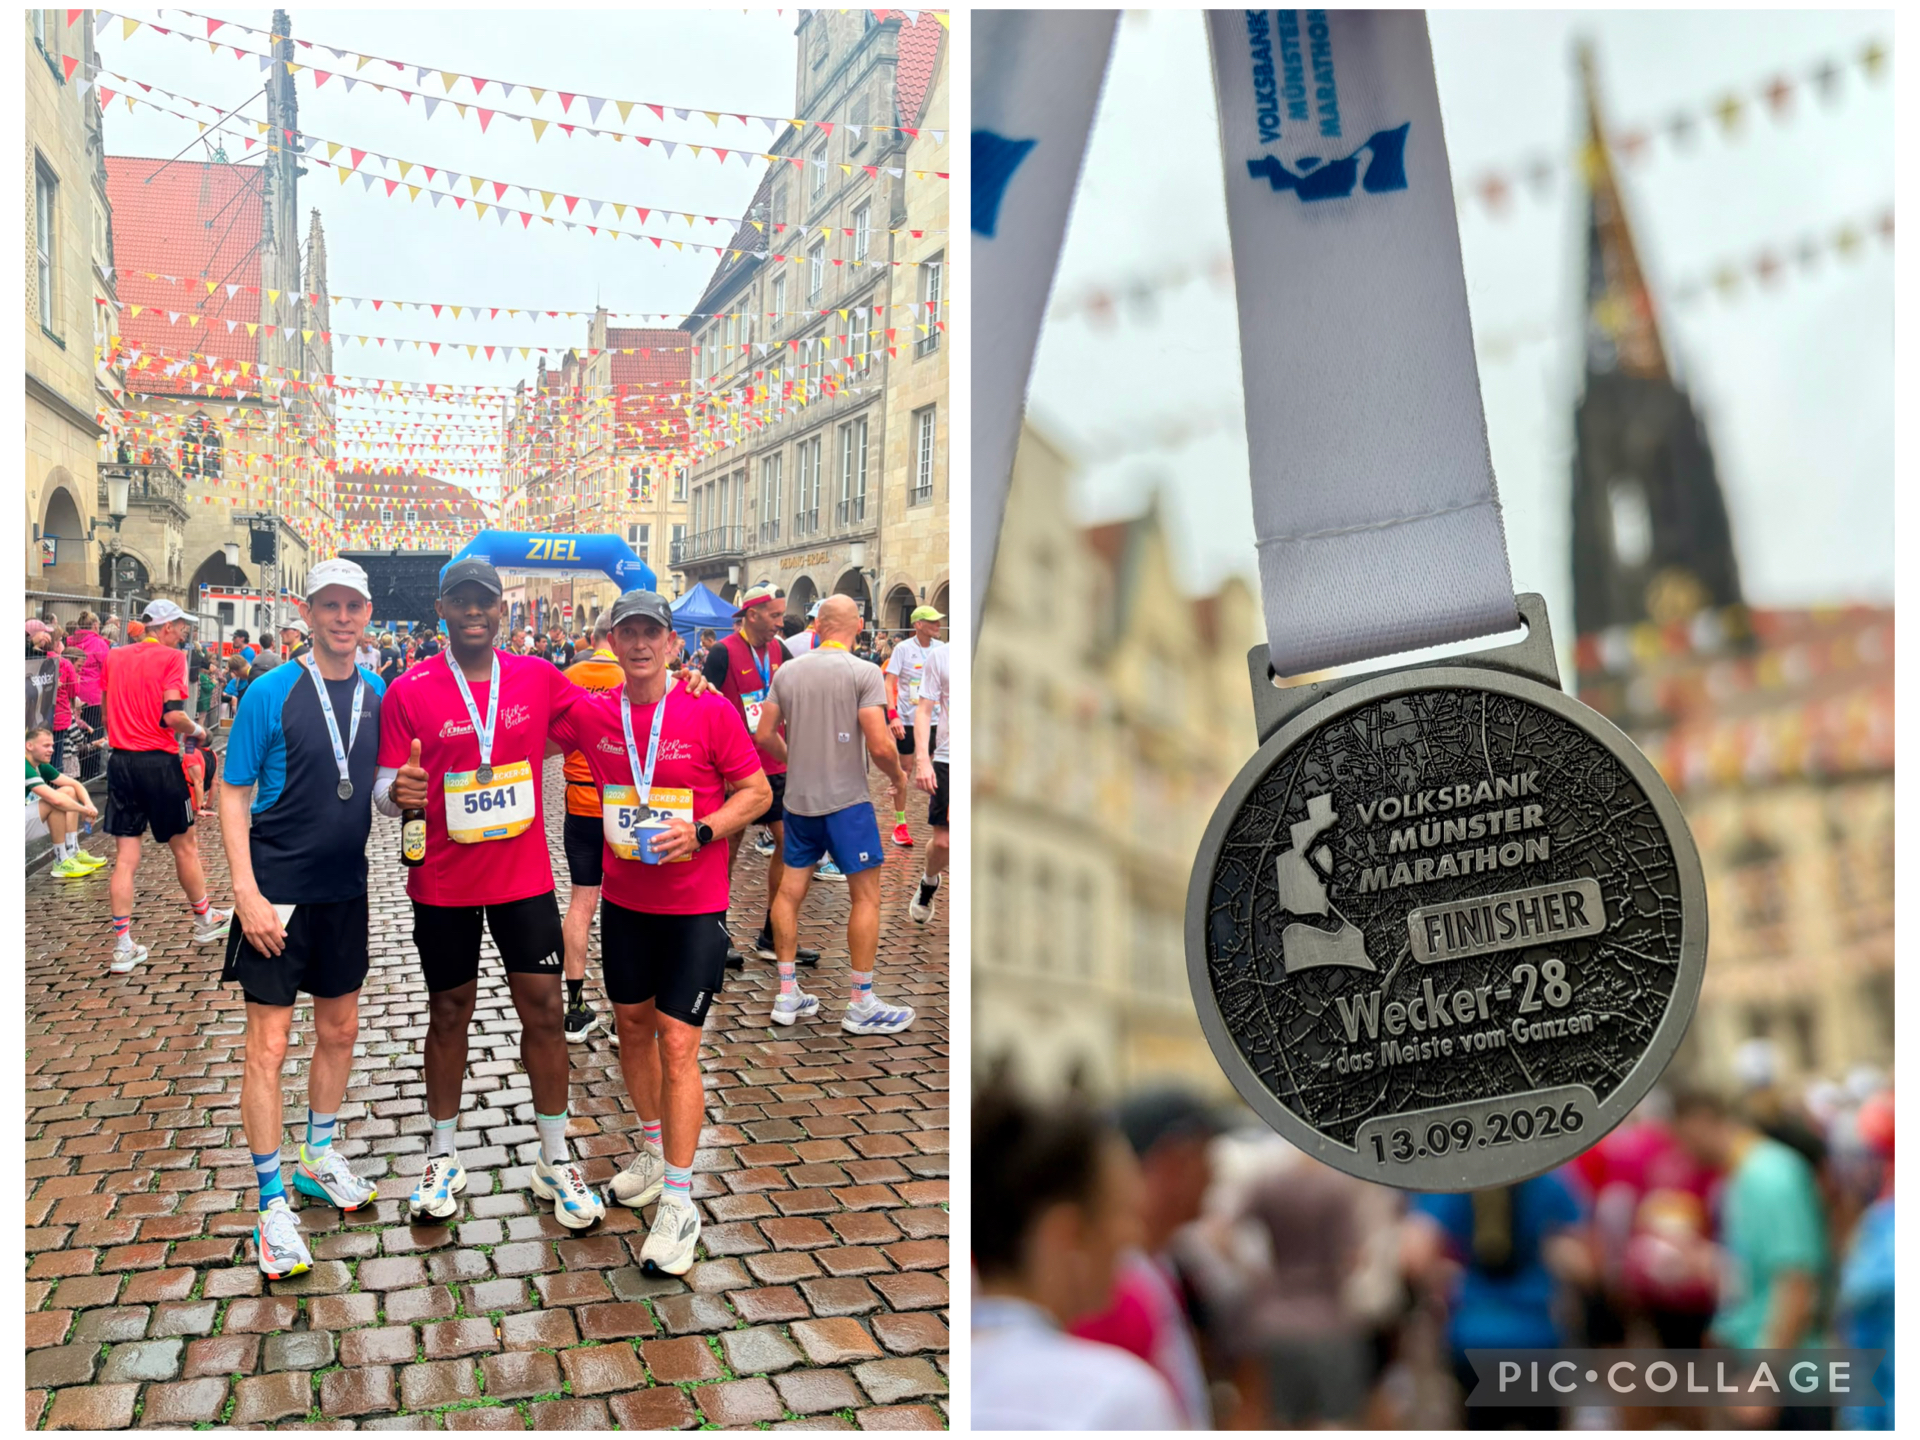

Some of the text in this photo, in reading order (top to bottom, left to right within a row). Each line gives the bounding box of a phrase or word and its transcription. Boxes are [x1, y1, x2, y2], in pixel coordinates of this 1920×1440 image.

[1246, 9, 1282, 144] VOLKSBANK
[525, 538, 581, 561] ZIEL
[449, 770, 529, 787] 2026 ECKER-28
[464, 786, 516, 814] 5641
[609, 791, 690, 804] 2026 ECKER-28
[1357, 770, 1542, 826] VOLKSBANK
[1388, 804, 1545, 855] MÜNSTER
[1359, 836, 1550, 895] MARATHON
[1424, 890, 1591, 955] FINISHER
[691, 991, 705, 1014] FUSION
[1335, 959, 1572, 1043] Wecker-28
[1336, 1047, 1374, 1075] das
[1380, 1036, 1453, 1067] Meiste
[1459, 1028, 1506, 1053] vom
[1511, 1013, 1594, 1044] Ganzen
[1369, 1100, 1584, 1165] 13.09.2026
